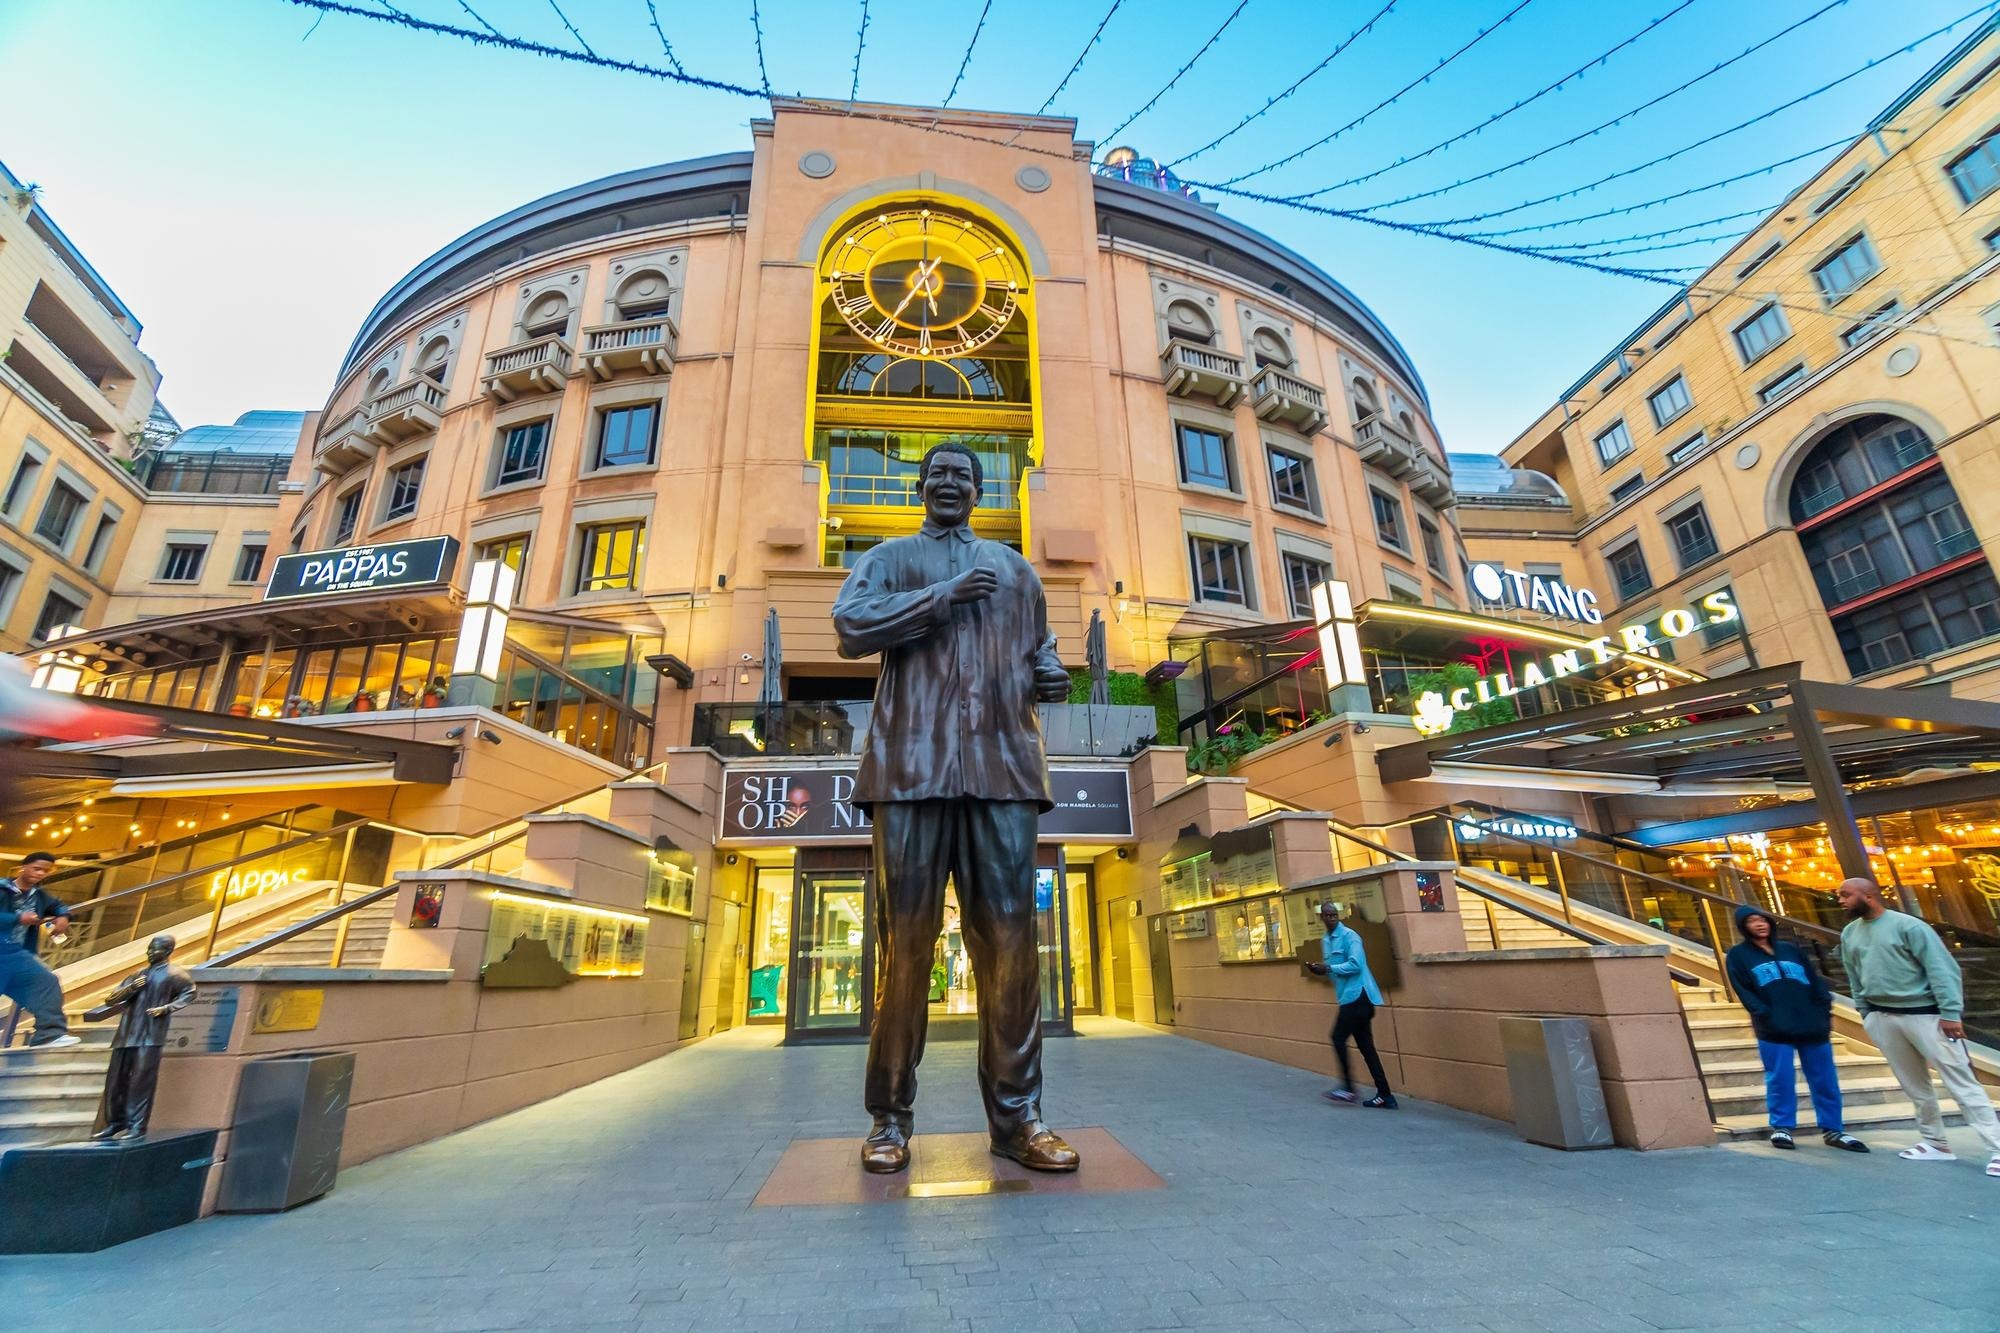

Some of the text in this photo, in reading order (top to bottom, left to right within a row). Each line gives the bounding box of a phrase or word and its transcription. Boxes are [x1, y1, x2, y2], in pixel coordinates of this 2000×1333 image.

[299, 551, 409, 587] PAPPAS
[326, 579, 375, 591] ON THE SQUARE
[1503, 567, 1603, 625] TANG
[1450, 590, 1738, 712] CILANTROS
[741, 776, 792, 803] SH
